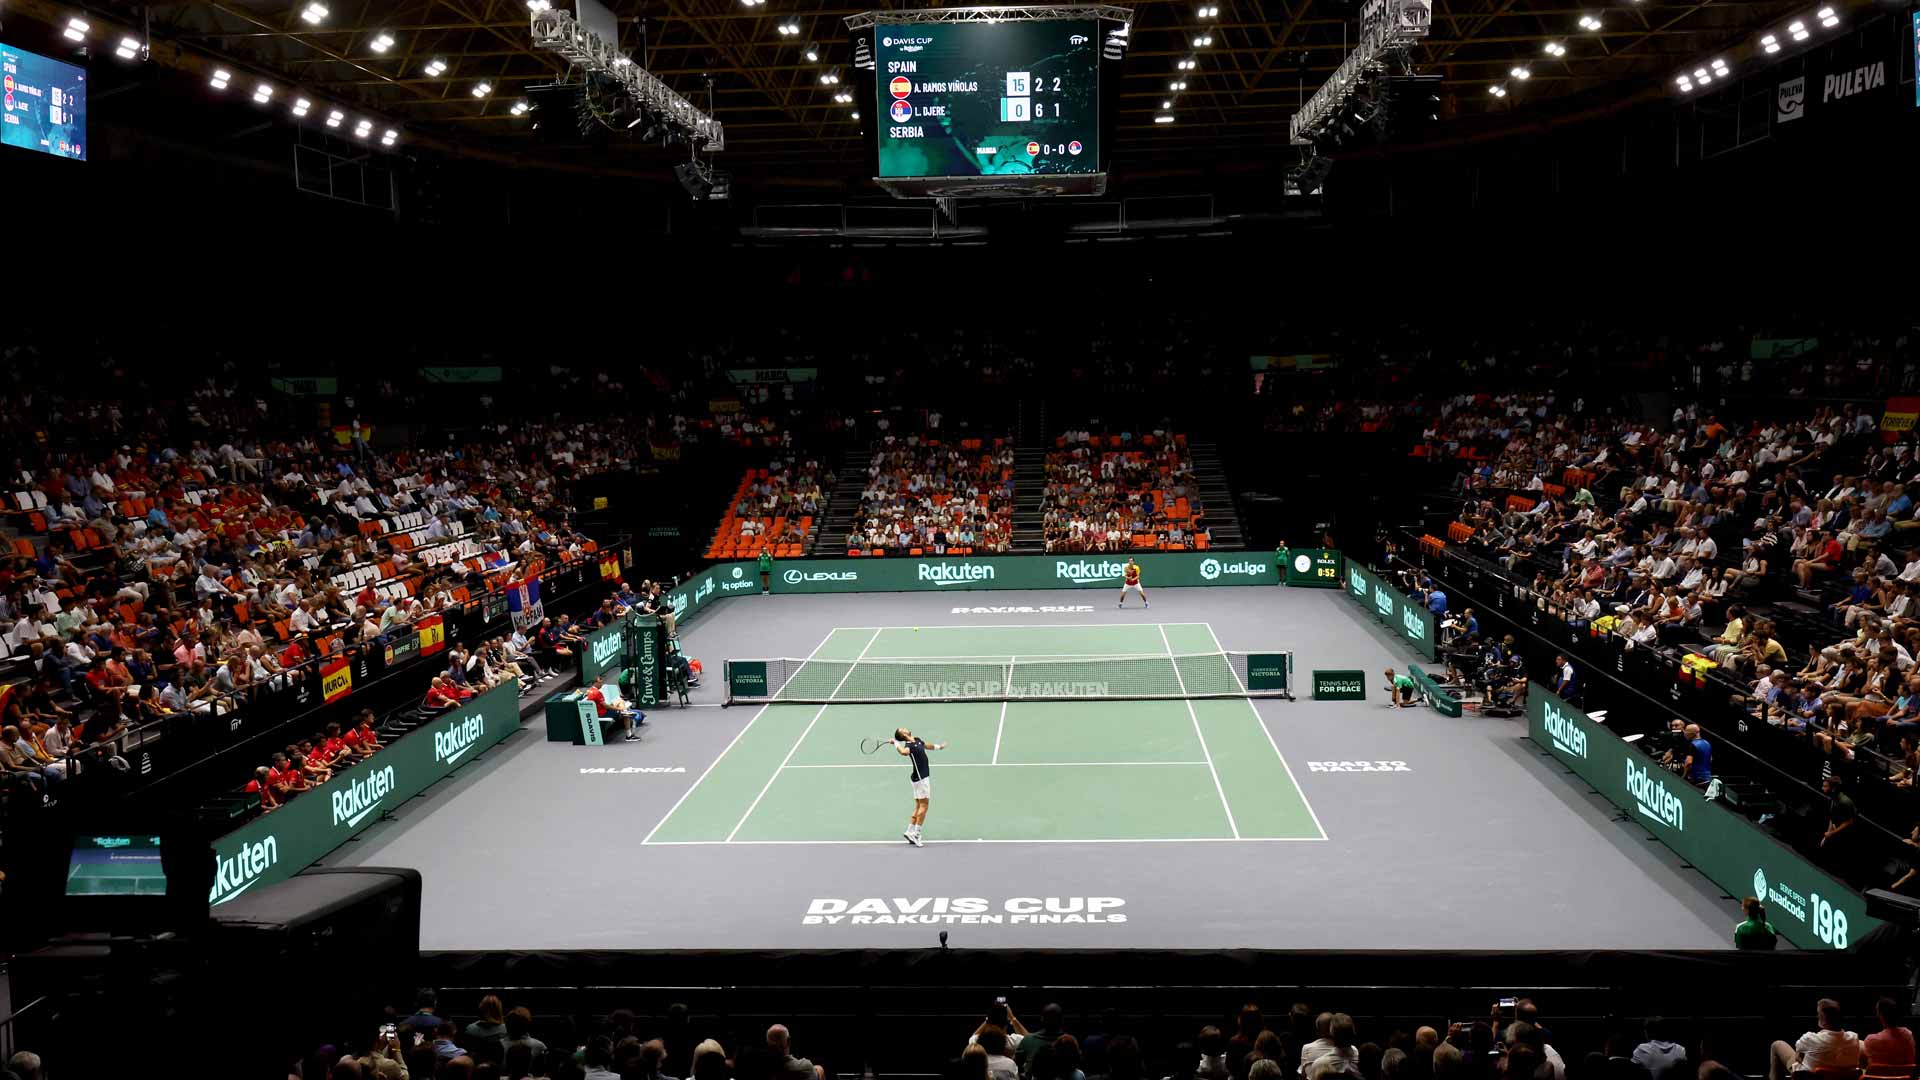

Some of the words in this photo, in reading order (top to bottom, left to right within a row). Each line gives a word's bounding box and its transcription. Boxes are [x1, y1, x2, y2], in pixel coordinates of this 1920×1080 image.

[888, 61, 917, 73] SPAIN
[914, 83, 922, 93] A.
[923, 82, 947, 93] RAMOS
[947, 79, 978, 93] VIÑOLAS
[1012, 78, 1025, 92] 15
[1034, 78, 1043, 92] 2
[1052, 78, 1061, 92] 2
[1780, 84, 1803, 99] PULEVA
[1823, 61, 1885, 104] PULEVA
[914, 106, 922, 117] L.
[922, 105, 946, 117] DJERE
[1015, 104, 1023, 118] 0
[1034, 103, 1044, 117] 6
[1053, 103, 1060, 117] 1
[889, 127, 924, 139] SERBIA
[803, 571, 858, 582] LEXUS
[918, 562, 995, 581] Rakuten
[1223, 561, 1267, 576] LaLiga
[1317, 568, 1336, 578] 0:52
[730, 579, 754, 590] option
[1351, 567, 1367, 596] Rakuten
[1374, 584, 1394, 616] Rakuten
[1403, 604, 1425, 640] Rakuten
[593, 630, 622, 664] Rakuten
[904, 682, 960, 697] DAVIS
[963, 681, 1001, 696] CUP
[1031, 682, 1108, 696] RAKUTEN
[1336, 685, 1361, 693] PEACE
[435, 712, 484, 762] Rakuten
[1544, 701, 1587, 759] Rakuten
[332, 765, 395, 826] Rakuten
[1626, 757, 1683, 832] Rakuten
[208, 835, 277, 903] kuten
[1779, 882, 1793, 897] SERVE
[1793, 890, 1806, 907] SPEED
[806, 897, 989, 914] DAVIS
[1003, 897, 1127, 914] CUP
[1768, 887, 1806, 923] quadcode
[802, 914, 847, 925] BY
[850, 913, 1003, 924] RAKUTEN
[1010, 913, 1129, 924] FINALS
[1810, 893, 1848, 950] 198
